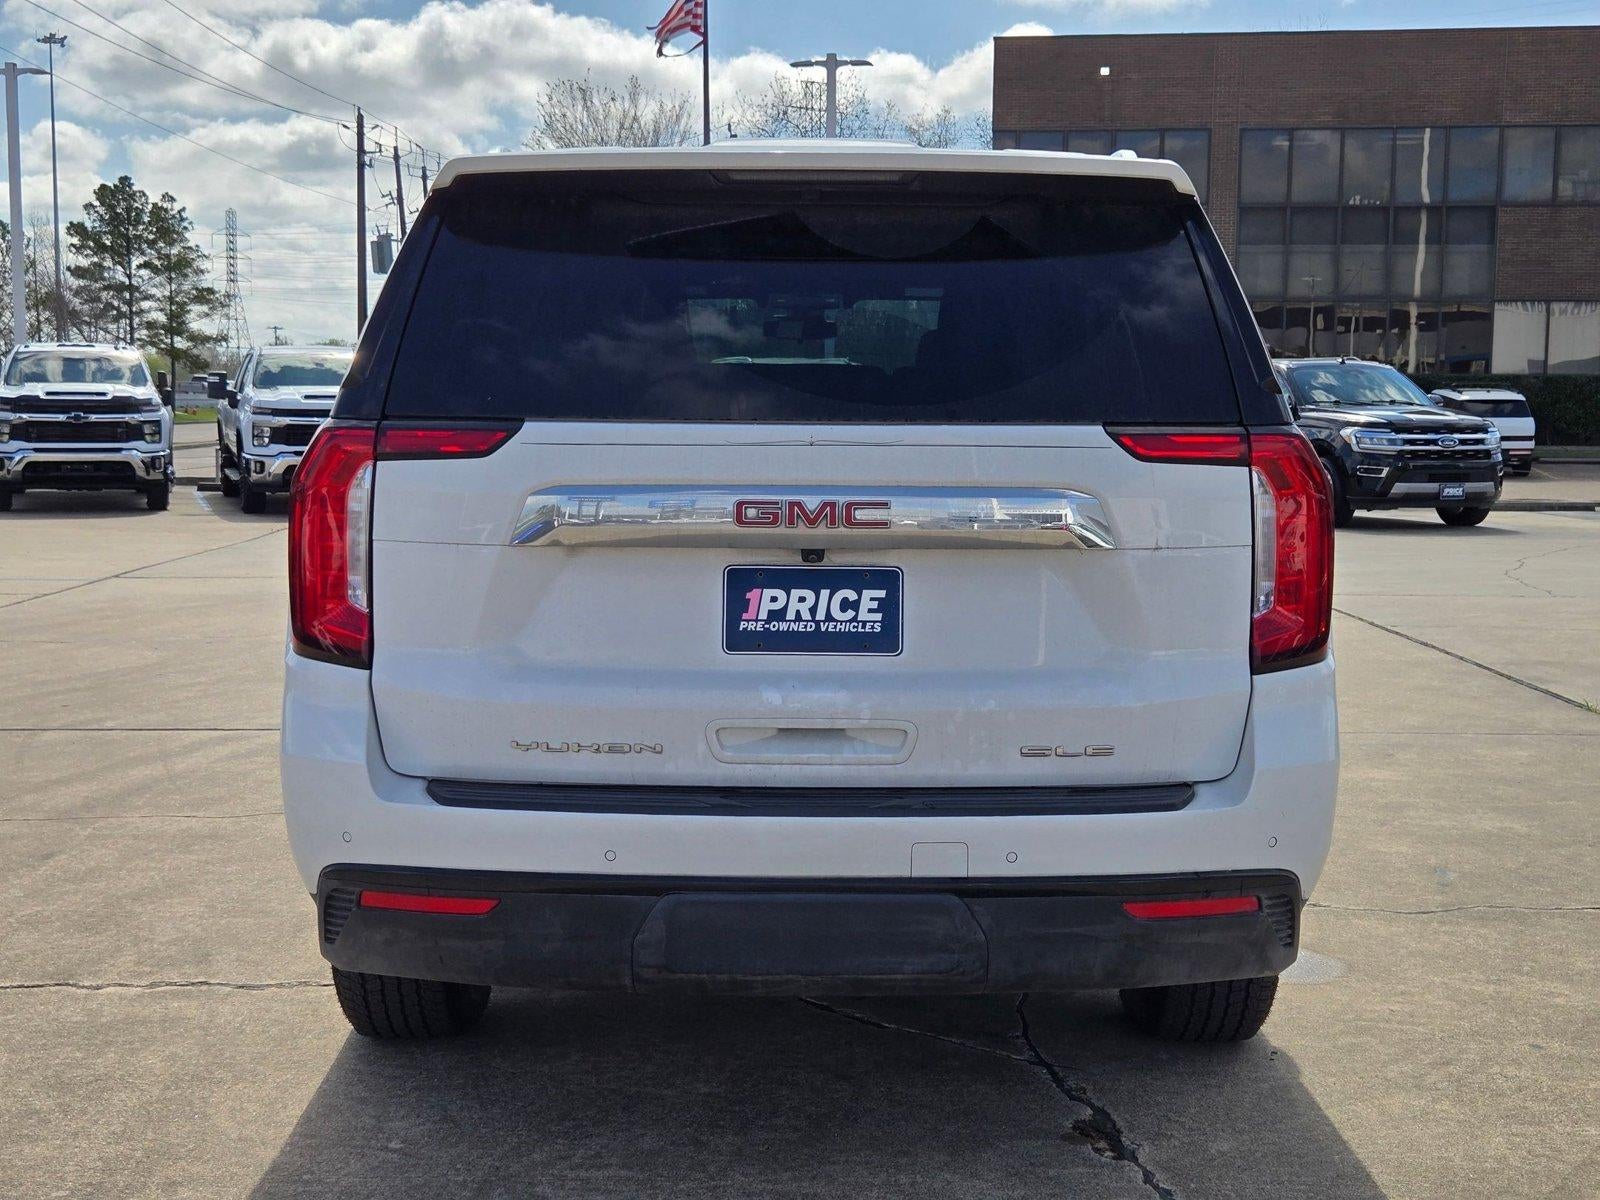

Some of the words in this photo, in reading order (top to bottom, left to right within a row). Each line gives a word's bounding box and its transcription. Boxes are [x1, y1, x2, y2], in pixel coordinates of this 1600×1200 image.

[733, 498, 891, 528] GMC
[739, 621, 815, 632] PRE-OWNED
[820, 622, 882, 633] VEHICLES
[510, 740, 663, 754] YUKON
[1020, 745, 1116, 757] SLE
